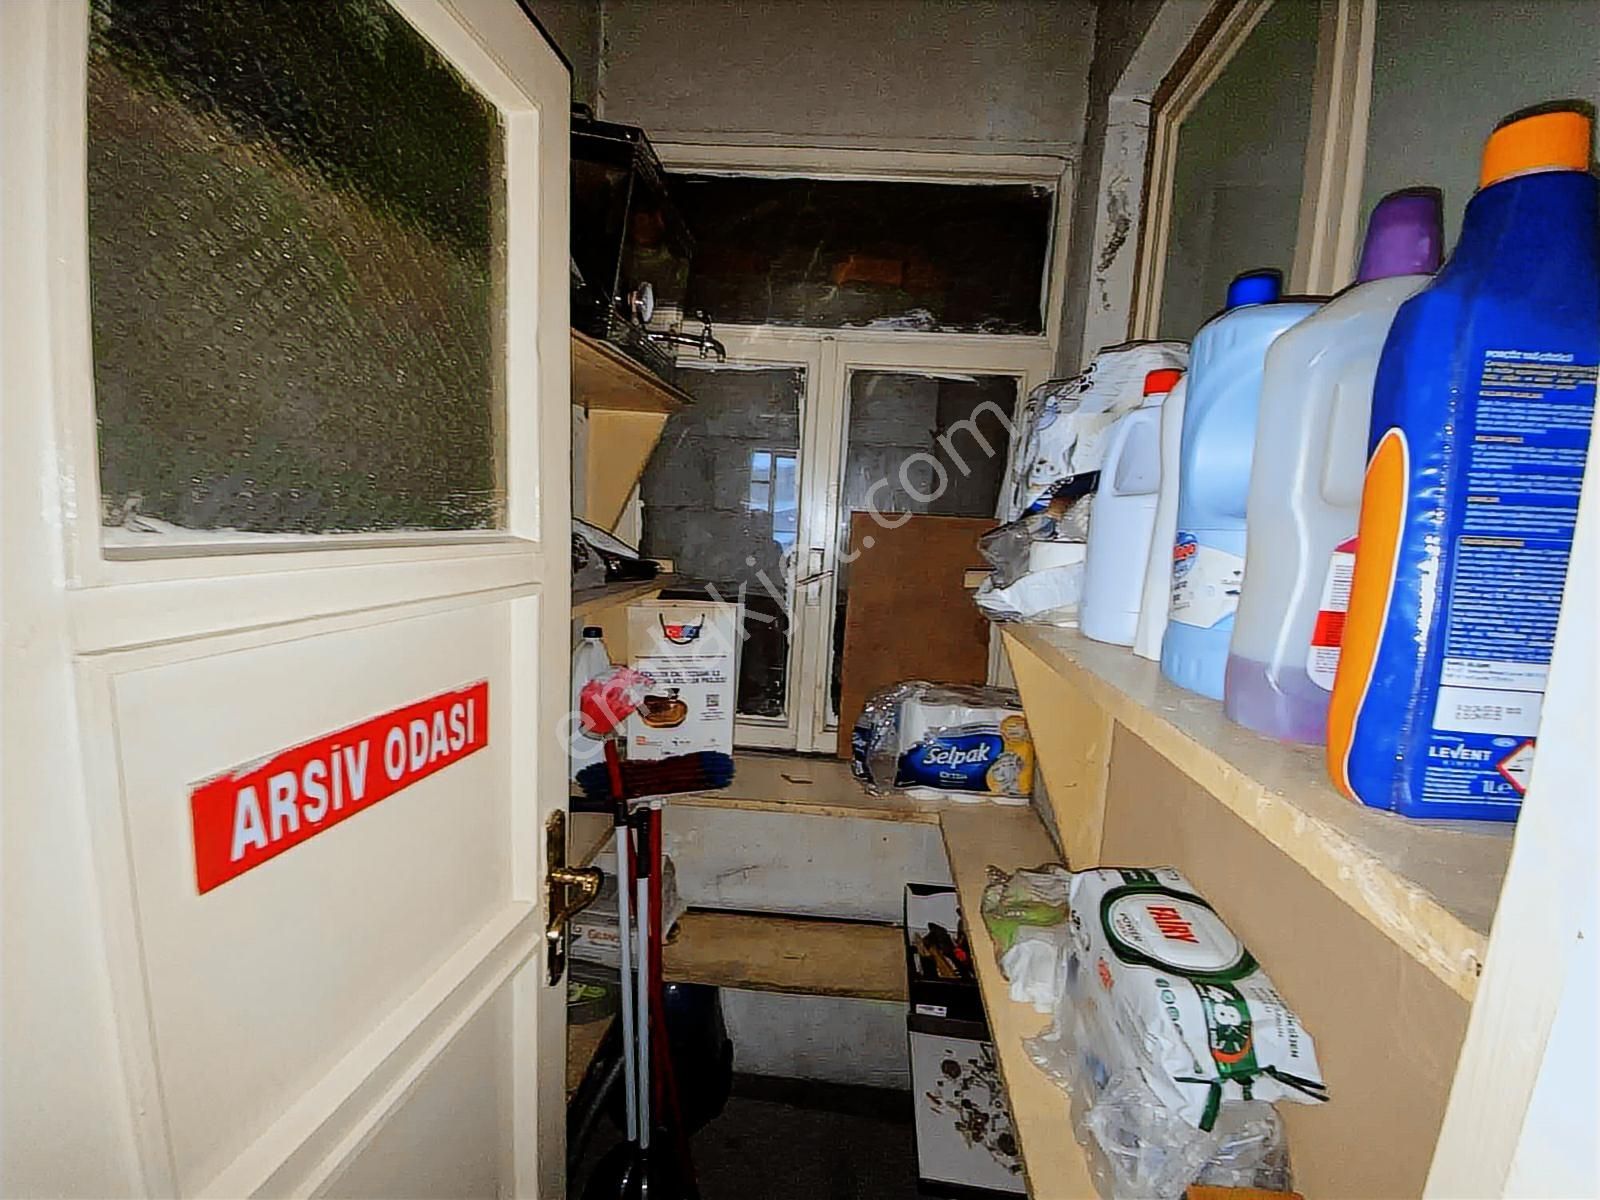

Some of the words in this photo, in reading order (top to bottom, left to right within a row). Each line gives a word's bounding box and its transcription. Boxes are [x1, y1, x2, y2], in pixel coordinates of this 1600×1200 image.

[384, 698, 476, 781] ODASI
[923, 742, 991, 769] Selpak
[1428, 743, 1493, 761] LEVENT
[1145, 904, 1200, 944] FAIRY
